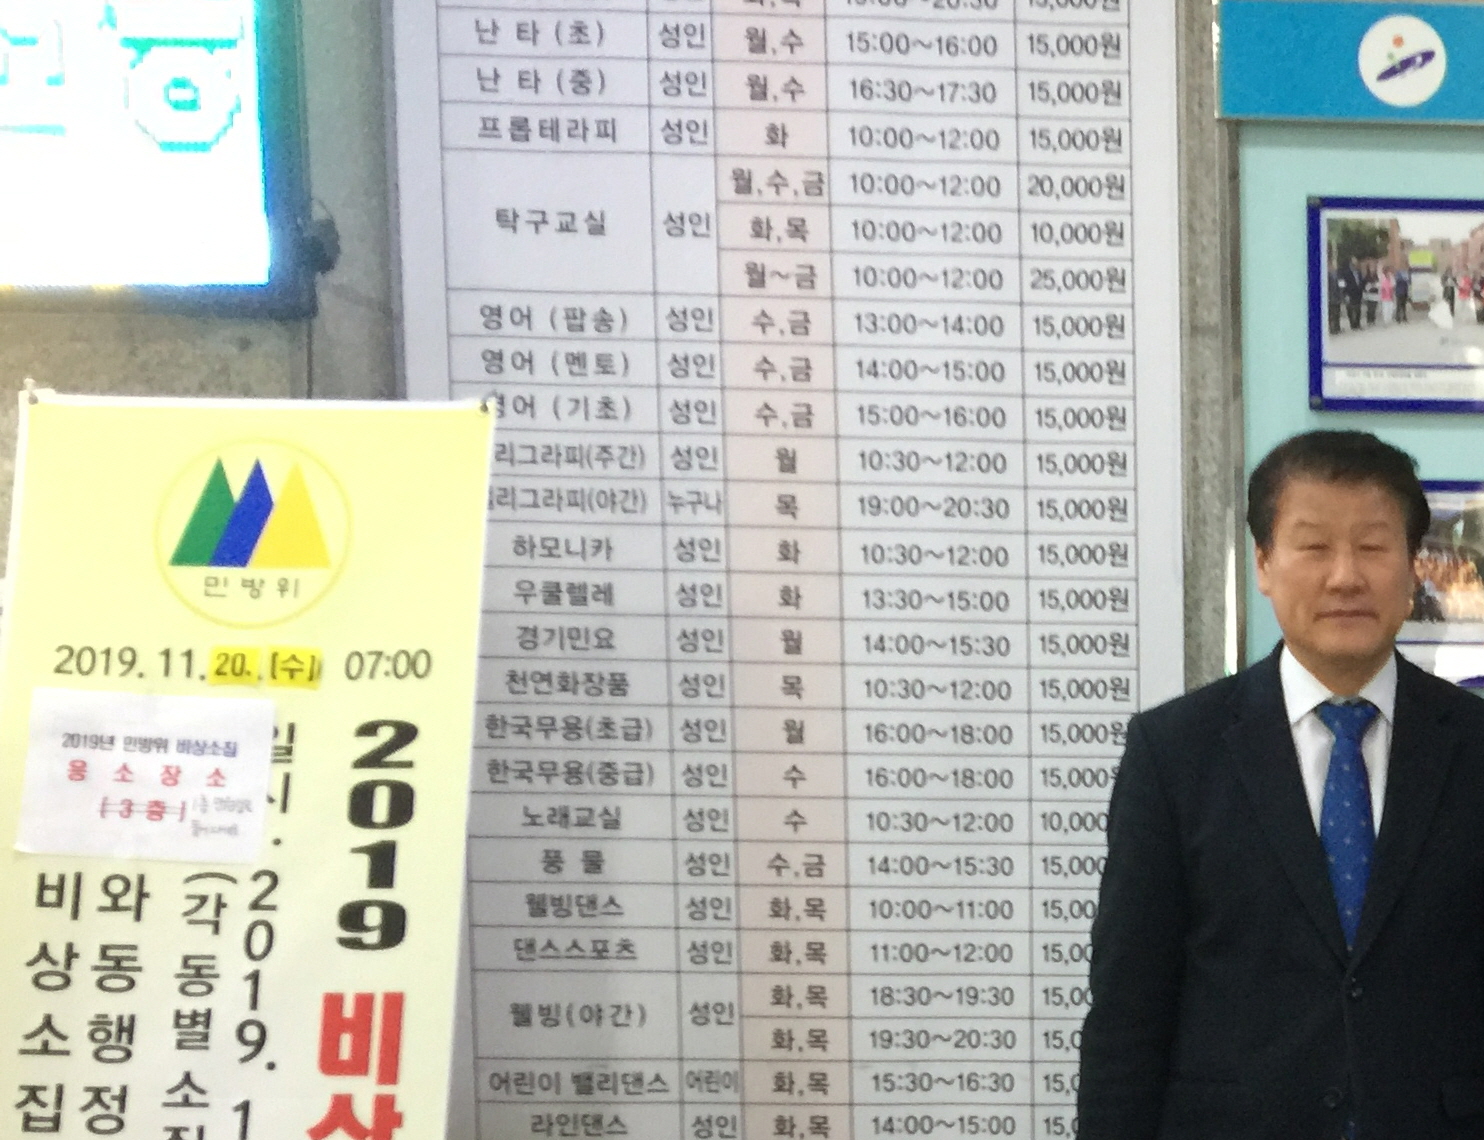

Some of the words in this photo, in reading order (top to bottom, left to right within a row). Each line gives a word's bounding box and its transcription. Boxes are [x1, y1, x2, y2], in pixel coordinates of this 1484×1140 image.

[659, 22, 706, 49] 성인
[848, 31, 998, 57] 15:00~16:00
[1028, 32, 1122, 59] 15,000원
[660, 70, 707, 97] 성인
[849, 78, 997, 104] 16:30~17:30
[1029, 80, 1122, 106] 15,000원
[661, 118, 708, 146] 성인
[765, 122, 789, 148] 화
[849, 125, 1000, 151] 10:00~12:00
[1029, 127, 1122, 153] 15,000원
[850, 172, 1001, 198] 10:00~12:00
[1028, 173, 1125, 201] 20,000원
[495, 208, 607, 236] 탁구교실
[663, 211, 711, 238] 성인
[851, 220, 1002, 245] 10:00~12:00
[1031, 221, 1125, 247] 10,000원
[853, 266, 1004, 292] 10:00~12:00
[1029, 267, 1126, 294] 25,000원
[666, 307, 714, 332] 성인
[855, 312, 1005, 337] 13:00~14:00
[1033, 314, 1125, 340] 15,000원
[668, 352, 716, 379] 성인
[856, 358, 1005, 383] 14:00~15:00
[1035, 359, 1126, 385] 15,000원
[669, 399, 717, 426] 성인
[857, 404, 1007, 428] 15:00~16:00
[1036, 405, 1127, 432] 15,000원
[671, 446, 719, 471] 성인
[777, 447, 798, 473] 월
[859, 449, 1008, 474] 10:30~12:00
[1037, 451, 1128, 477] 15,000원
[488, 487, 648, 514] 리그라피(야간)
[666, 490, 722, 515] 누구나
[776, 494, 798, 519] 목
[859, 495, 1010, 519] 19:00~20:30
[1037, 496, 1128, 522] 15,000원
[512, 535, 613, 560] 하모니카
[674, 536, 721, 563] 성인
[778, 539, 801, 564] 화
[861, 543, 1009, 567] 10:30~12:00
[1038, 542, 1129, 568] 15,000원
[676, 581, 723, 608] 성인
[779, 584, 802, 609] 화
[863, 588, 1010, 612] 13:30~15:00
[1039, 587, 1129, 613] 15,000원
[516, 625, 616, 652] 경기민요
[677, 628, 724, 654] 성인
[781, 629, 803, 655] 월
[863, 634, 1011, 657] 14:00~15:30
[1039, 632, 1129, 658] 15,000원
[344, 649, 433, 681] 07:00
[506, 669, 630, 698] 천연화장품
[782, 675, 804, 699] 목
[864, 678, 1012, 701] 10:30~12:00
[1040, 677, 1131, 702] 15,000원
[62, 733, 116, 751] 2019년
[484, 713, 654, 742] 한국무용(초급)
[783, 719, 804, 744] 월
[865, 722, 1013, 745] 16:00~18:00
[486, 759, 655, 786] 한국무용(중급)
[783, 765, 806, 789] 수
[866, 767, 1013, 789] 16:00~18:00
[336, 719, 420, 951] 2019
[522, 805, 622, 830] 노래교실
[784, 809, 807, 831] 수
[867, 811, 1014, 834] 10:30~12:00
[868, 856, 1014, 877] 14:00~15:30
[525, 893, 624, 918] 웰빙댄스
[869, 899, 1014, 920] 10:00~11:00
[513, 937, 638, 962] 댄스스포츠
[871, 943, 1013, 963] 11:00~12:00
[871, 986, 1015, 1007] 18:30~19:30
[870, 1029, 1016, 1050] 19:30~20:30
[489, 1071, 561, 1096] 어린이
[685, 1069, 738, 1094] 어린이
[872, 1072, 1015, 1093] 15:30~16:30
[531, 1113, 628, 1137] 라인댄스
[872, 1115, 1016, 1136] 14:00~15:00
